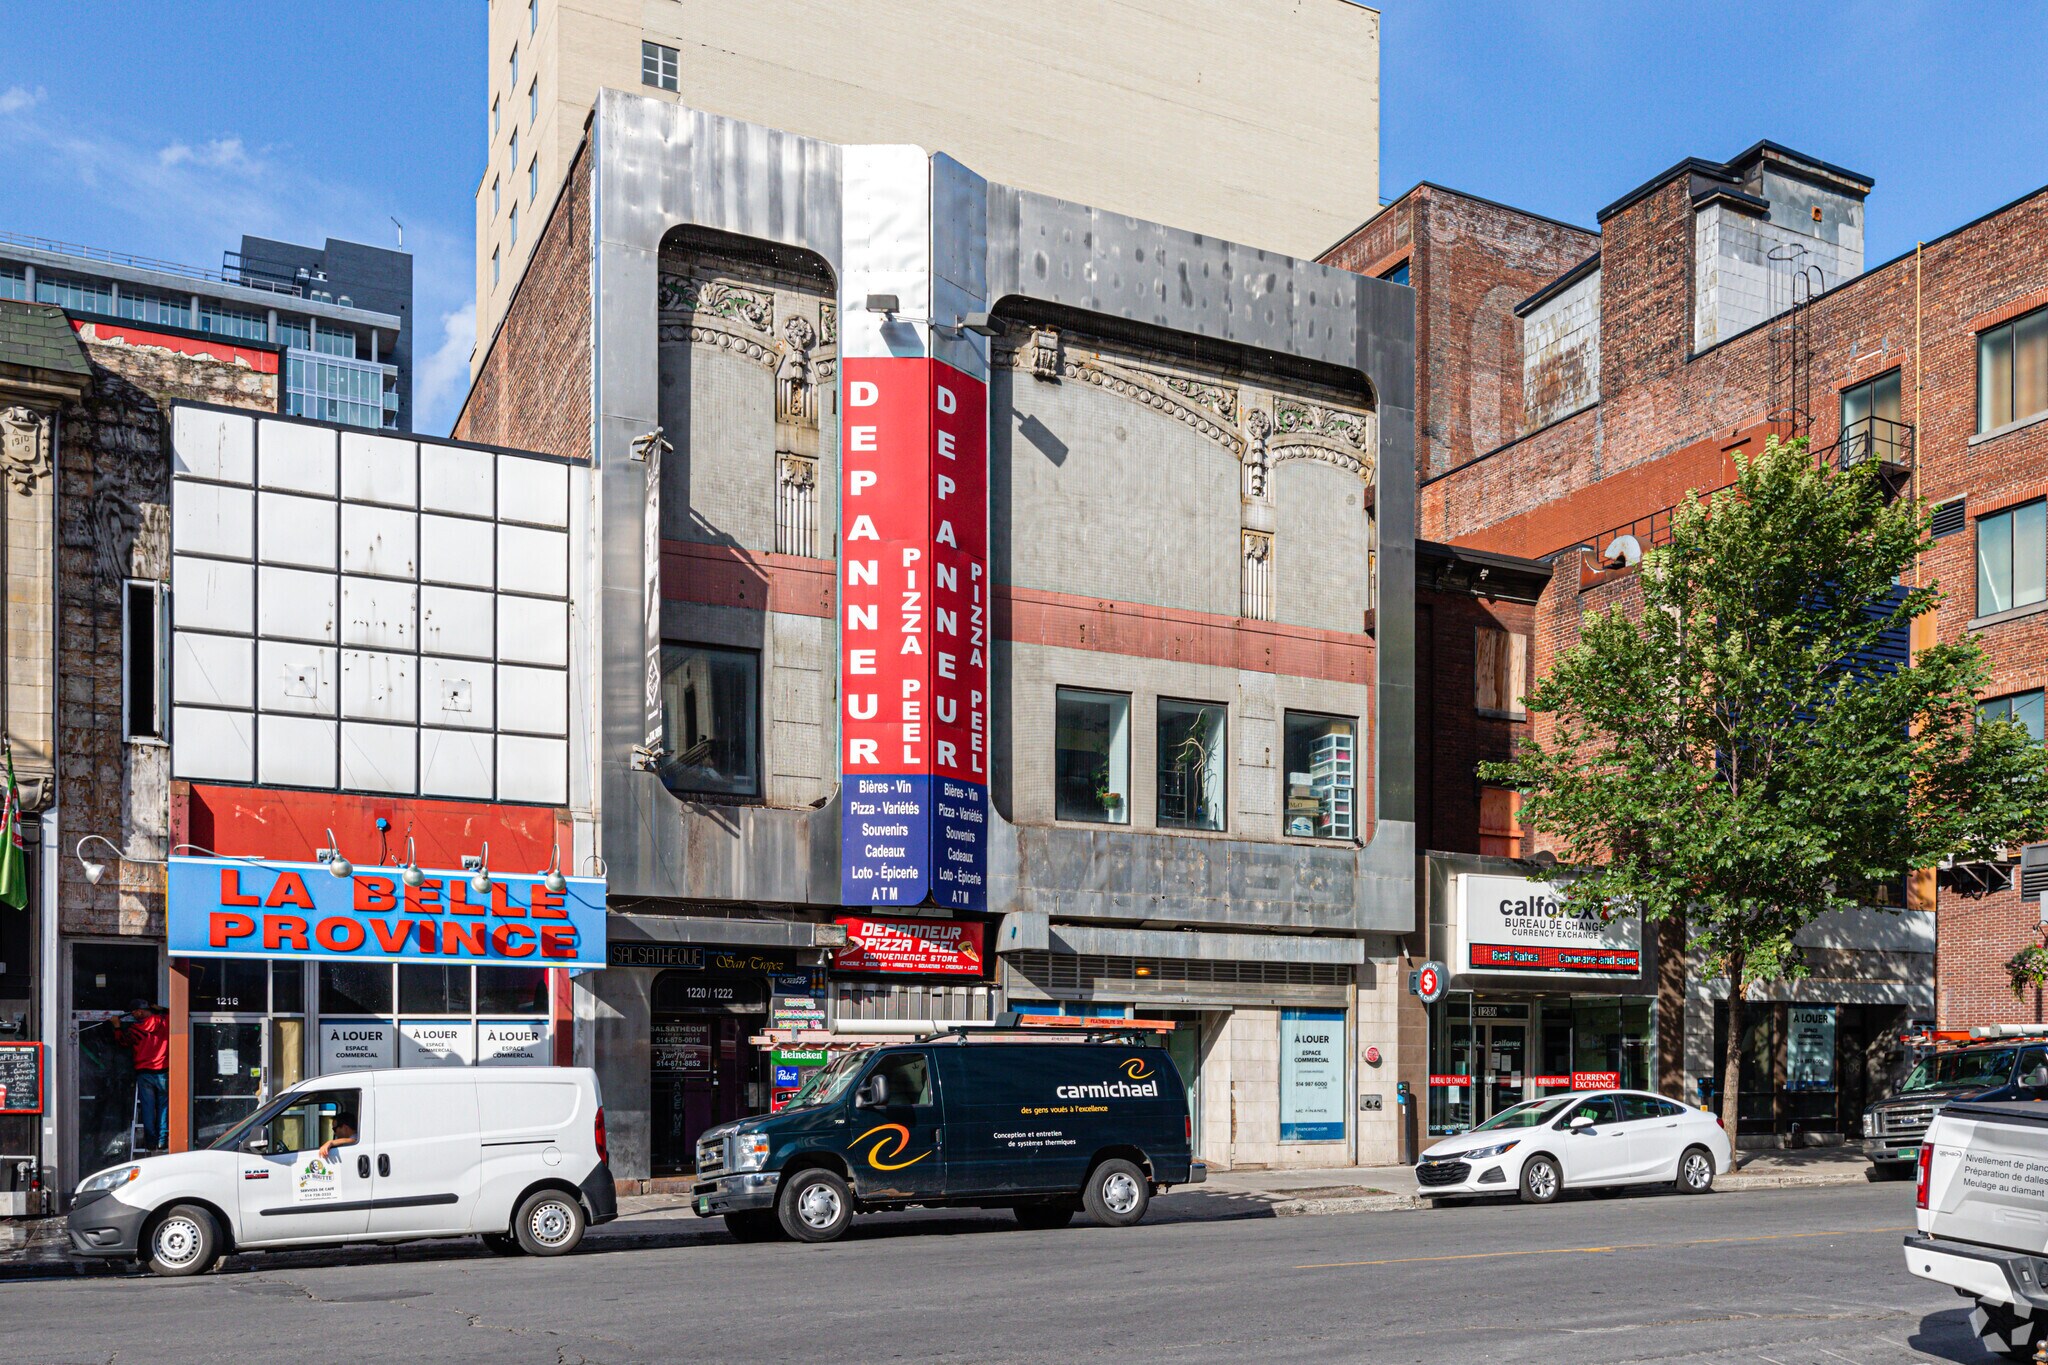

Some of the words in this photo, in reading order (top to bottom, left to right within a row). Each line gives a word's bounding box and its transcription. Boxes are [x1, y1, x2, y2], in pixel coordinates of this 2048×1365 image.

[847, 381, 880, 764] DEPANNEUR
[936, 385, 958, 768] DEPANNEUR
[901, 548, 922, 654] PIZZA
[970, 562, 983, 668] PIZZA
[902, 679, 921, 764] PEEL
[971, 690, 983, 773] PEEL
[859, 780, 888, 793] Bières
[896, 780, 911, 793] Vin
[944, 783, 964, 799] Bières
[968, 787, 978, 801] Vin
[851, 802, 875, 815] Pizza
[882, 801, 919, 815] Variétés
[938, 803, 955, 818] Pizza
[960, 807, 983, 823] Variétés
[862, 823, 908, 836] Souvenirs
[946, 825, 975, 842] Souvenirs
[865, 844, 905, 857] Cadeaux
[948, 847, 973, 863] Cadeaux
[852, 866, 873, 879] Loto
[881, 863, 918, 881] Épicerie
[940, 867, 953, 881] Loto
[958, 867, 981, 885] Épicerie
[220, 869, 315, 909] LA
[353, 875, 569, 920] BELLE
[861, 922, 962, 939] DEPANNEUR
[1505, 918, 1546, 929] BUREAU
[1549, 920, 1561, 929] DE
[1565, 921, 1605, 932] CHANGE
[209, 912, 578, 959] PROVINCE
[1512, 929, 1554, 938] CURRENCY
[1558, 930, 1598, 939] EXCHANGE
[919, 940, 958, 953] PEEL
[716, 955, 746, 969] San
[749, 956, 784, 973] Tropez
[931, 955, 958, 963] STORE
[1492, 950, 1511, 961] Best
[1598, 955, 1614, 965] and
[1420, 962, 1438, 972] BUREAU
[686, 987, 706, 998] 1220
[714, 988, 733, 998] 1222
[216, 997, 239, 1005] 1216
[1801, 1014, 1828, 1024] LOUER
[330, 1029, 340, 1041] À
[342, 1031, 383, 1041] LOUER
[413, 1029, 421, 1039] À
[423, 1031, 457, 1039] LOUER
[487, 1030, 495, 1041] À
[499, 1032, 539, 1041] LOUER
[1294, 1033, 1300, 1043] À
[1302, 1035, 1329, 1043] LOUER
[781, 1051, 822, 1059] Heineken
[777, 1070, 797, 1080] Pabst
[1430, 1076, 1445, 1084] BUREAU
[1451, 1076, 1467, 1084] CHANGE
[1056, 1080, 1158, 1099] carmichael
[1034, 1107, 1049, 1115] gens
[1070, 1105, 1074, 1113] à
[1075, 1105, 1108, 1113] l'excellence
[993, 1132, 1026, 1140] Conception
[1017, 1139, 1043, 1148] systèmes
[1045, 1138, 1076, 1147] thermiques
[1965, 1154, 2012, 1167] Nivellement
[2013, 1160, 2024, 1169] de
[1964, 1166, 2010, 1179] Préparation
[2012, 1173, 2022, 1181] de
[2024, 1175, 2048, 1185] dalles
[1963, 1178, 1996, 1191] Meulage
[2011, 1185, 2045, 1197] diamant
